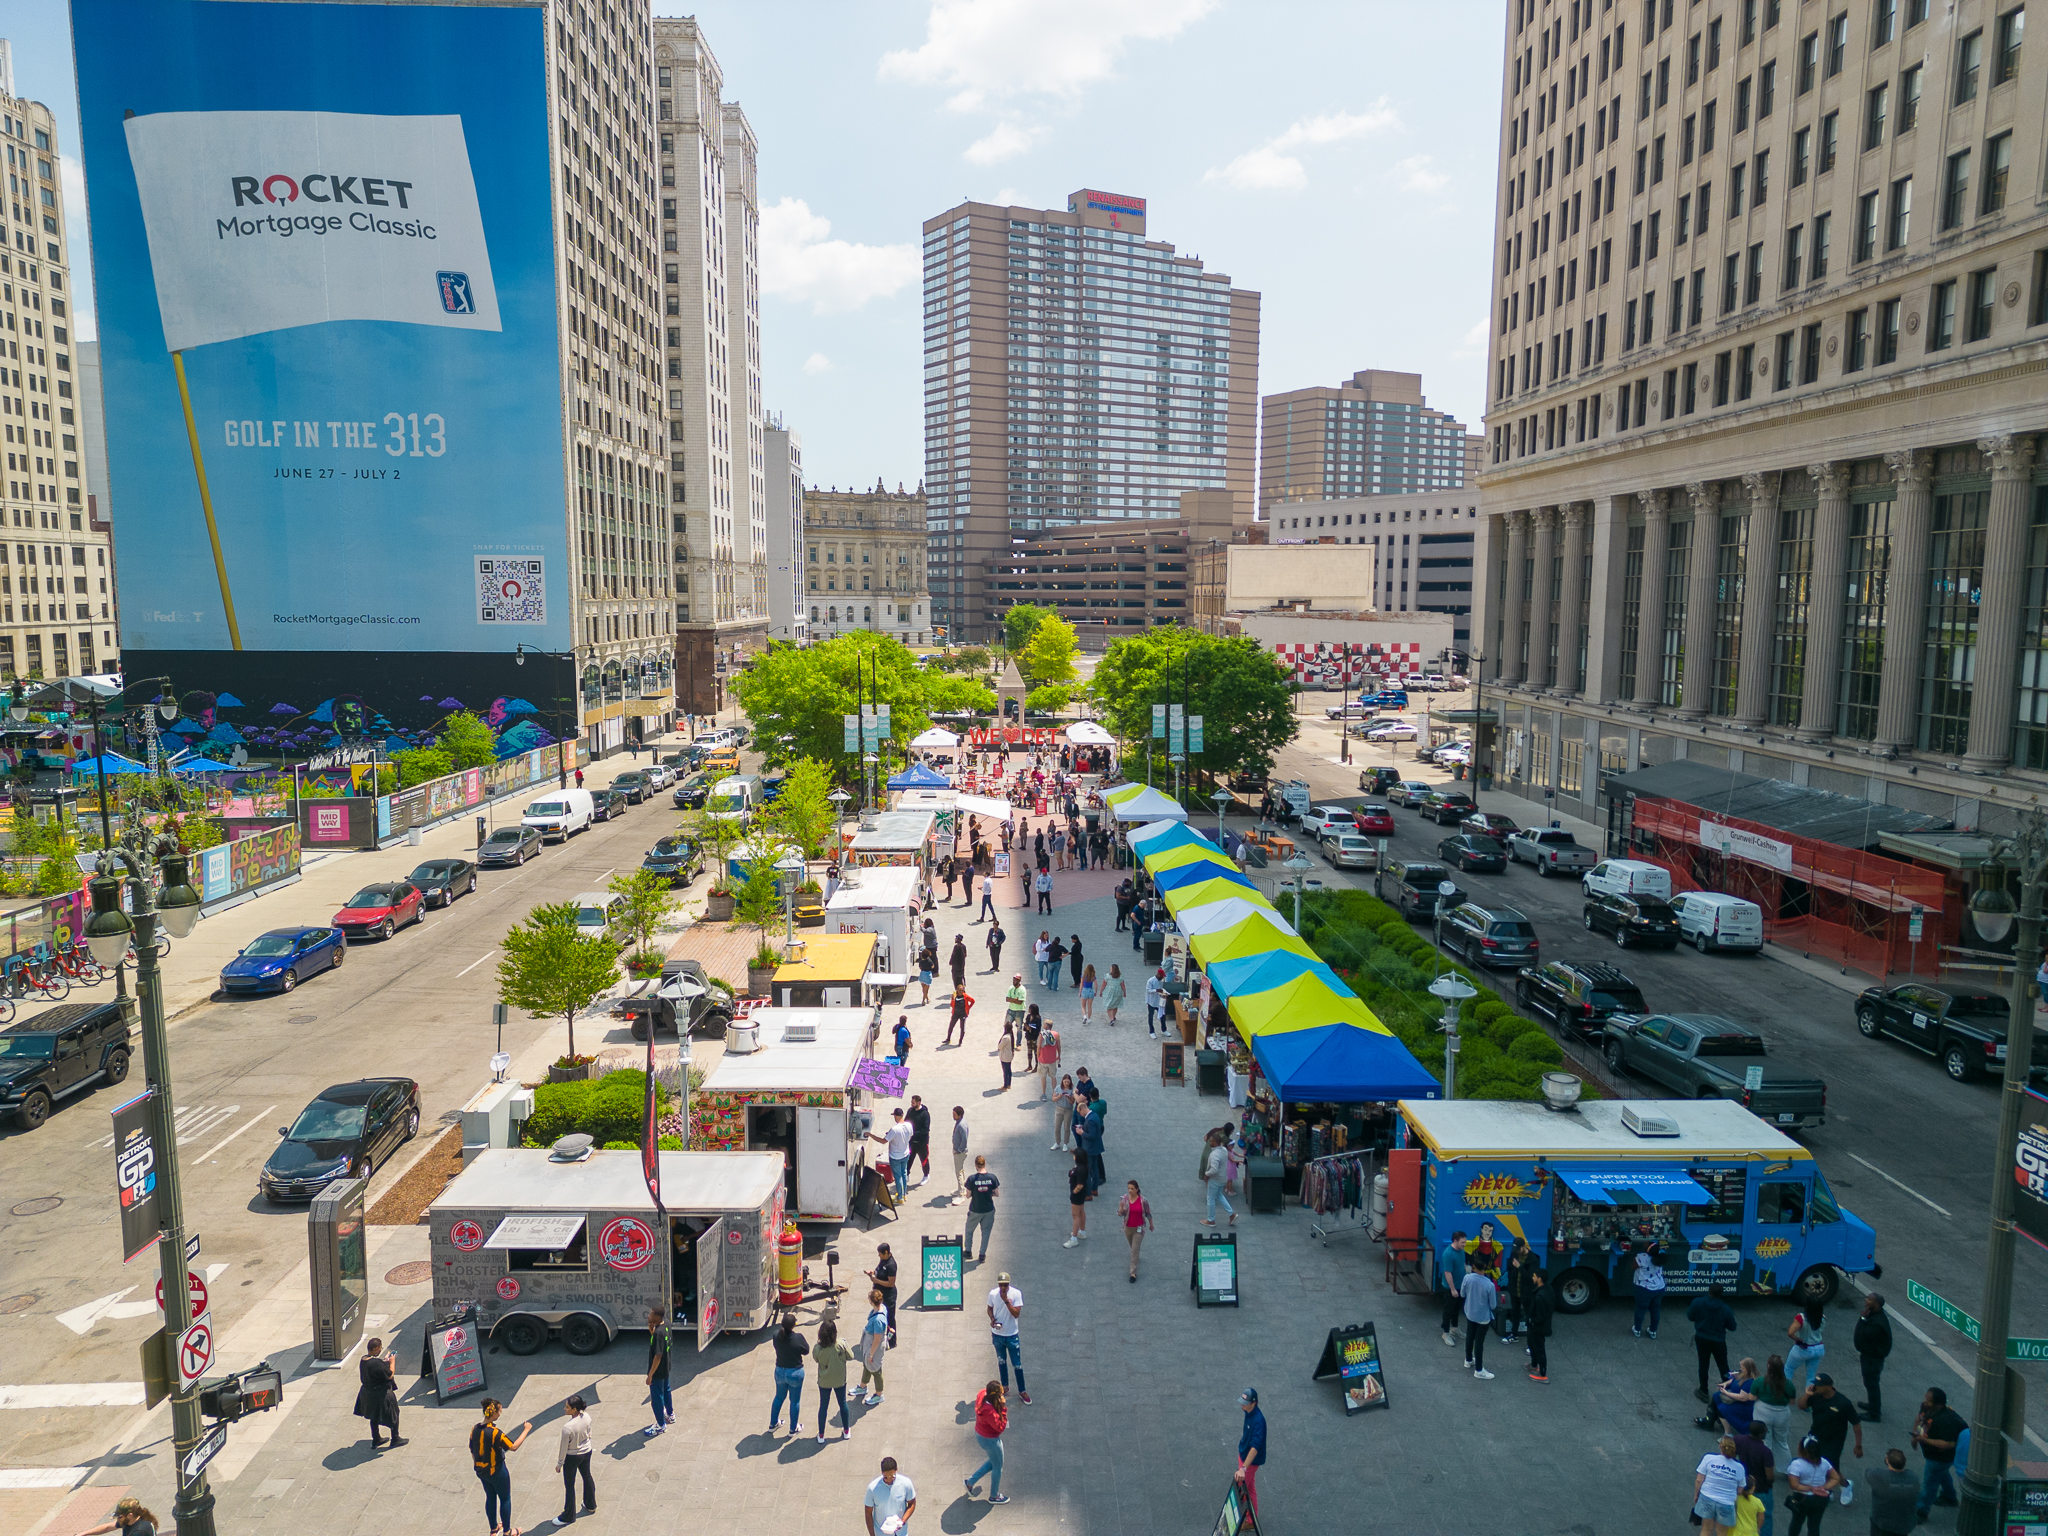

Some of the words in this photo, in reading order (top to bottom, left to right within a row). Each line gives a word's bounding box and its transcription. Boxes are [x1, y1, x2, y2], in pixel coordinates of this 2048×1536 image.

[231, 174, 413, 209] ROCKET
[1087, 190, 1144, 209] RENAISSANCE
[1112, 206, 1144, 216] APARTMENTS
[216, 212, 343, 240] Mortgage
[348, 212, 437, 240] Classic
[442, 282, 456, 310] TOUR
[224, 420, 286, 447] GOLF
[294, 421, 320, 448] IN
[327, 421, 377, 448] THE
[383, 412, 447, 457] 313
[274, 468, 312, 479] JUNE
[319, 468, 334, 479] 27
[353, 469, 387, 480] JULY
[393, 469, 401, 480] 2
[273, 614, 420, 626] RocketMortgageClassic.com
[969, 728, 1001, 744] WE
[1022, 728, 1059, 744] DET
[210, 859, 223, 871] MID
[211, 868, 223, 878] WAY
[840, 925, 856, 934] ELLIS
[118, 1136, 152, 1163] DETROIT
[119, 1146, 153, 1188] GP
[1469, 1178, 1518, 1190] HERO
[1462, 1196, 1522, 1206] VILLAIN
[462, 1254, 491, 1263] SEAFOOD
[604, 1250, 634, 1264] Seafood
[634, 1246, 656, 1258] Truck
[448, 1266, 506, 1276] LOBSTER
[927, 1270, 957, 1278] ZONES
[566, 1273, 620, 1284] CATFISH
[566, 1294, 644, 1305] SWORDFISH
[1912, 1284, 1957, 1323] Cadillac
[1965, 1317, 1978, 1339] Sq
[1346, 1341, 1367, 1352] HERO
[196, 1445, 208, 1465] ONE
[210, 1430, 224, 1451] WAY
[1711, 1464, 1736, 1474] cobra
